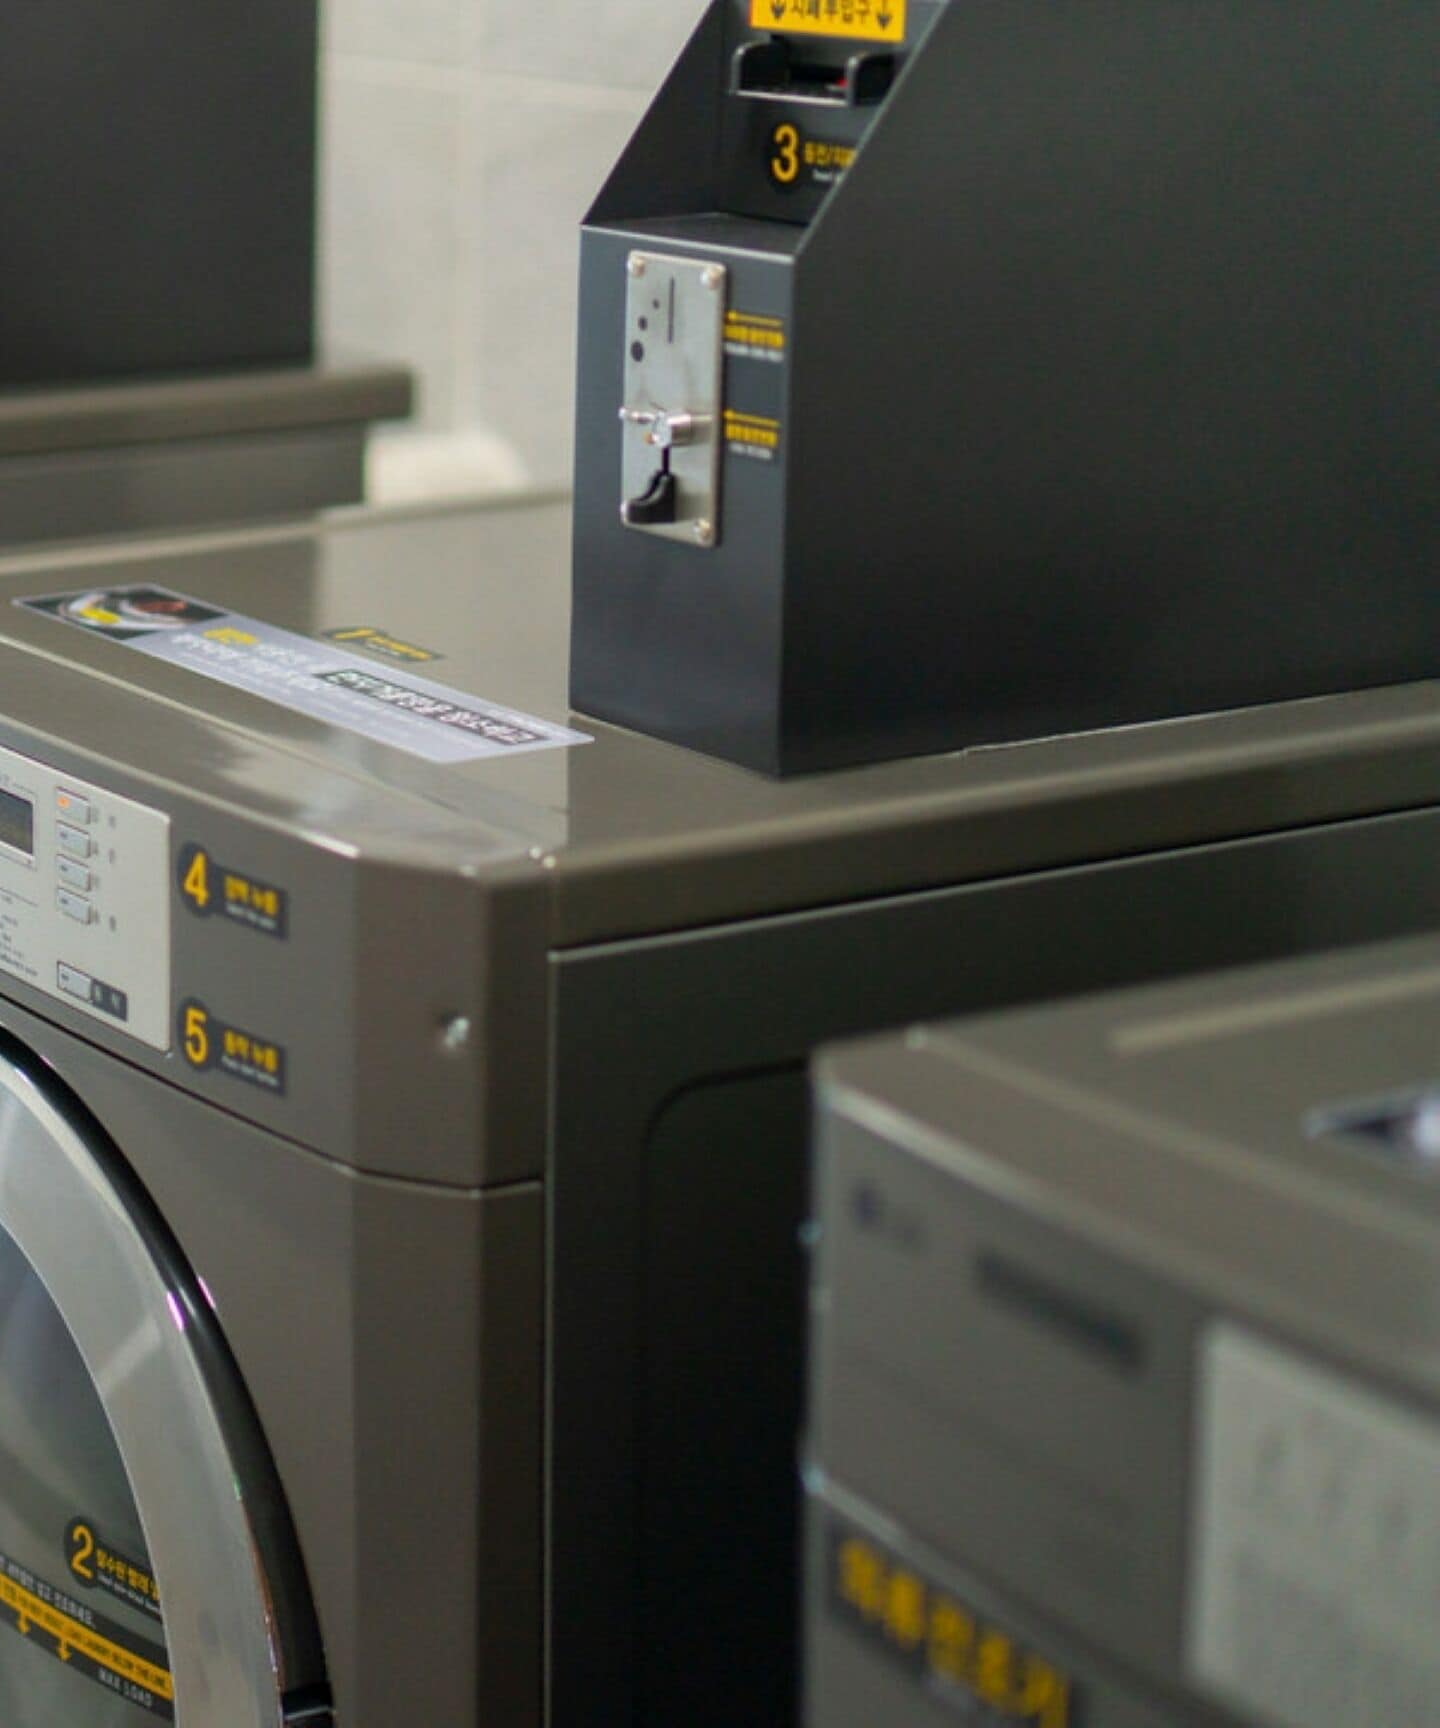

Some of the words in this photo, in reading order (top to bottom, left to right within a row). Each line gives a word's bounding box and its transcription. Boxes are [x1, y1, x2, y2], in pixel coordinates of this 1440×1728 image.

[771, 122, 800, 184] 3
[183, 850, 209, 908] 4
[184, 1006, 209, 1066] 5
[70, 1524, 94, 1580] 2
